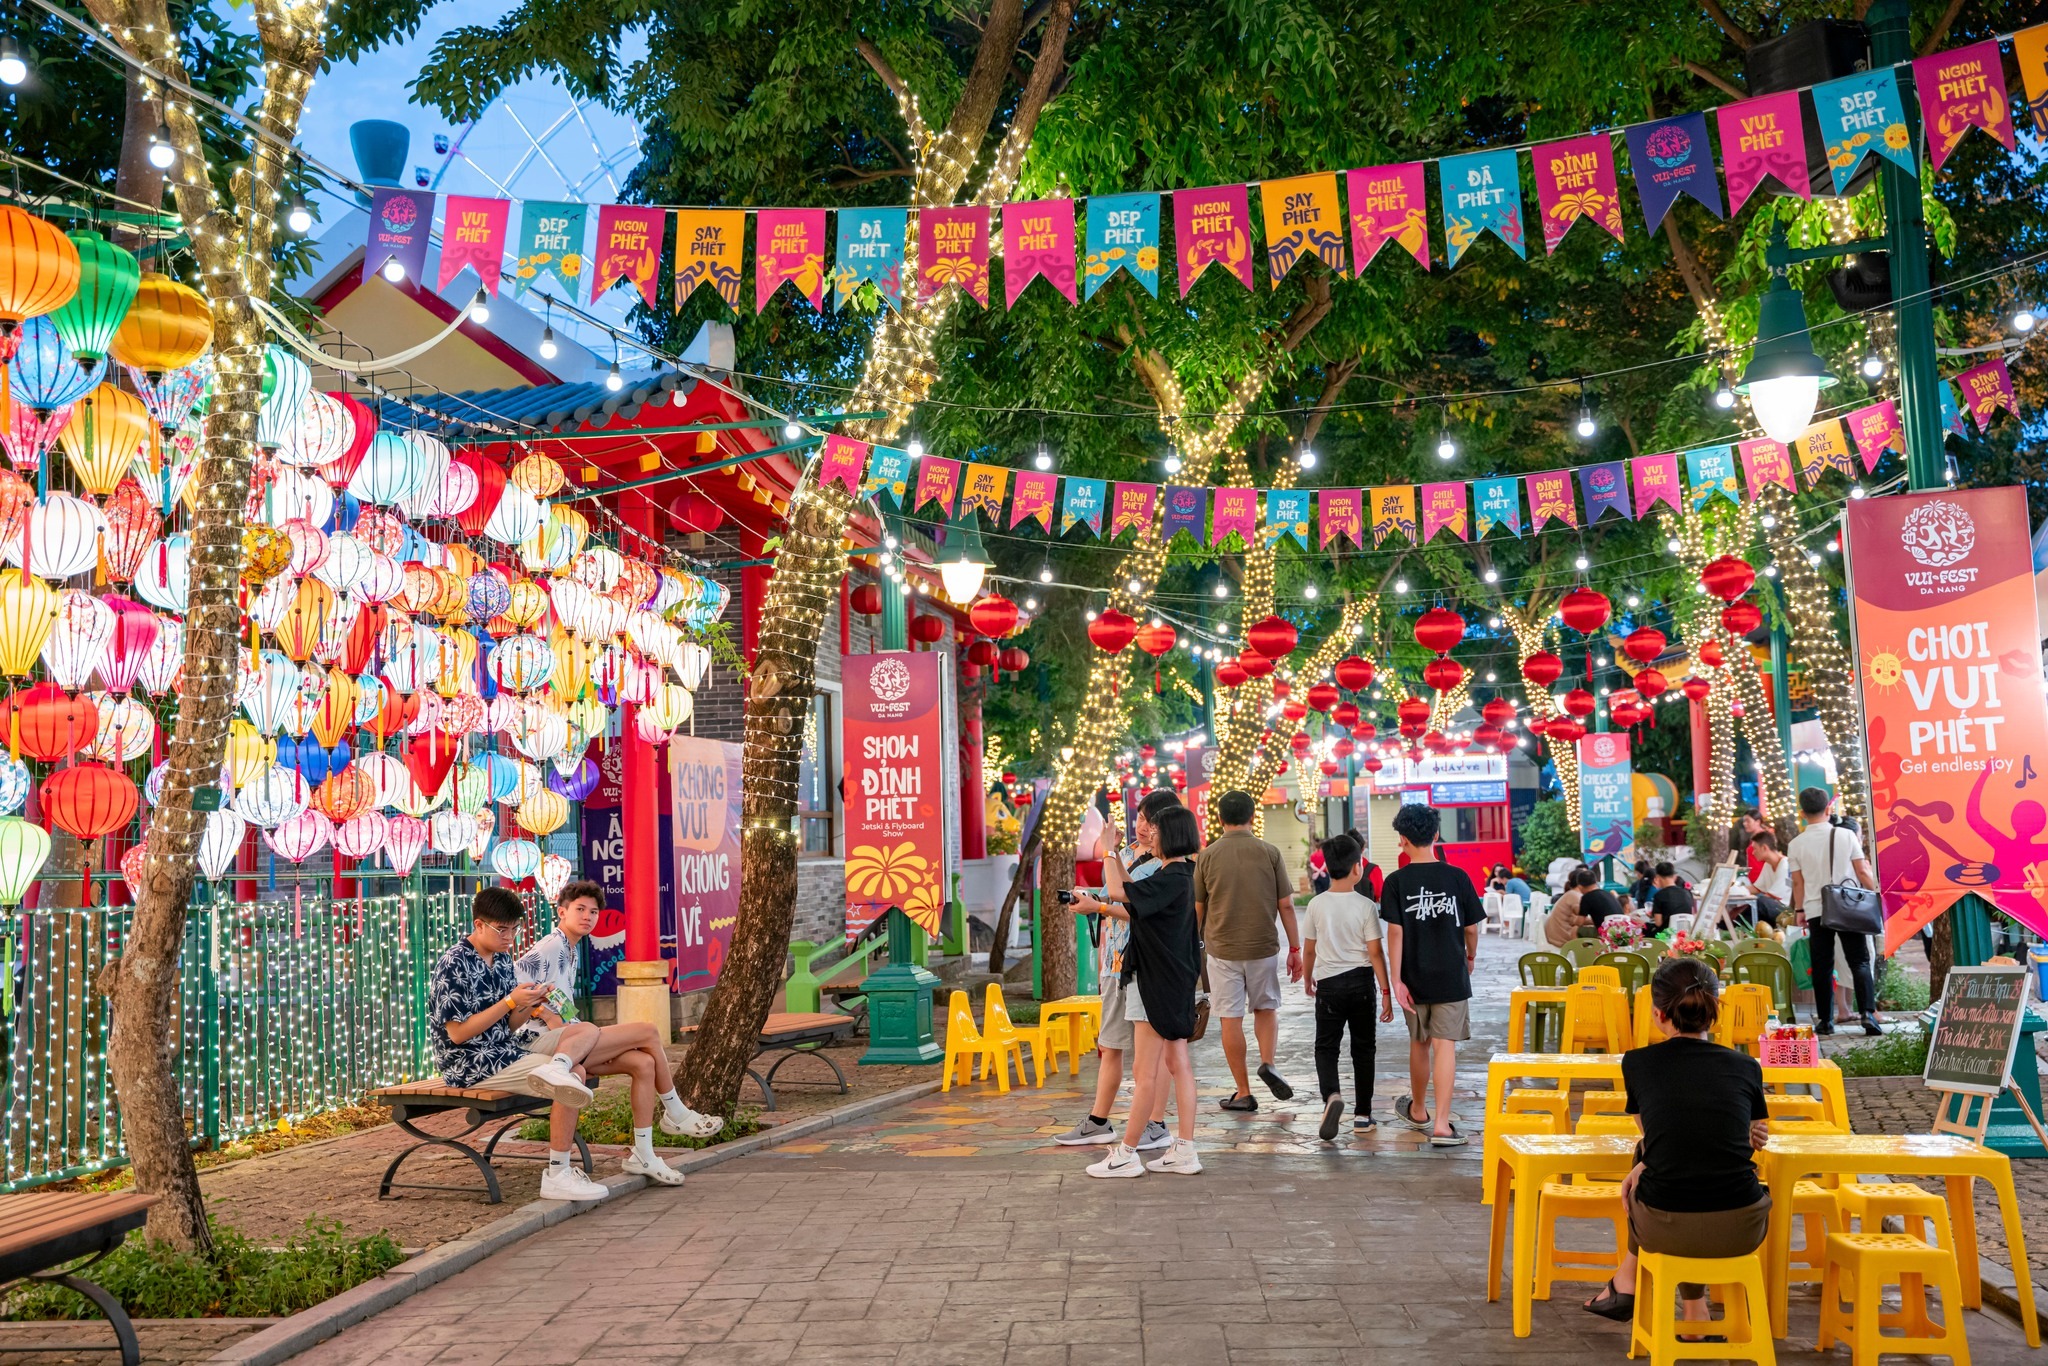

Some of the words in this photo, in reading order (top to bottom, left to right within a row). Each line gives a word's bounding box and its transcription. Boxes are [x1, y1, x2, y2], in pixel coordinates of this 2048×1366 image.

[1938, 59, 1982, 81] NGON
[1938, 74, 1988, 103] PHẾT
[1840, 90, 1877, 115] ĐẸP
[1739, 113, 1776, 135] VUI
[1840, 108, 1886, 132] PHẾT
[1739, 131, 1784, 153] PHẾT
[1551, 151, 1599, 176] ĐỈNH
[1367, 176, 1405, 195] CHILL
[1284, 192, 1313, 211] SAY
[1365, 193, 1408, 213] PHẾT
[1457, 187, 1505, 209] PHẾT
[1193, 201, 1230, 216] NGON
[1282, 208, 1321, 226] PHẾT
[461, 212, 488, 227] VUI
[538, 218, 568, 233] ĐẸP
[614, 220, 647, 233] NGON
[1021, 217, 1052, 235] VUI
[1108, 211, 1141, 229] ĐẸP
[1191, 215, 1234, 235] PHẾT
[456, 227, 491, 243] PHẾT
[695, 226, 722, 241] SAY
[774, 221, 806, 237] CHILL
[933, 218, 976, 240] ĐỈNH
[1104, 227, 1145, 245] PHẾT
[534, 233, 571, 250] PHẾT
[610, 232, 649, 251] PHẾT
[690, 240, 726, 256] PHẾT
[770, 237, 809, 254] PHẾT
[848, 240, 890, 258] PHẾT
[1019, 233, 1058, 251] PHẾT
[1809, 432, 1826, 445] SAY
[1751, 443, 1776, 455] NGON
[929, 464, 950, 474] NGON
[1643, 465, 1663, 475] VUI
[976, 474, 994, 483] SAY
[1025, 481, 1046, 490] CHILL
[1225, 497, 1243, 507] VUI
[1383, 496, 1400, 506] SAY
[1433, 489, 1455, 499] CHILL
[1905, 567, 1979, 587] VUI-FEST
[1920, 586, 1934, 595] DA
[1937, 584, 1966, 594] NANG
[1907, 621, 1990, 662] CHƠI
[1901, 663, 2001, 711] VUI
[870, 702, 910, 713] VUI-FEST
[1909, 708, 2005, 756] PHẾT
[863, 735, 919, 760] SHOW
[1900, 758, 1928, 775] Get
[1931, 755, 1986, 773] endless
[1990, 756, 2014, 774] joy
[677, 761, 724, 800] KHÔNG
[861, 760, 921, 796] ĐỈNH
[866, 792, 918, 821] PHẾT
[679, 802, 709, 841] VUI
[861, 822, 884, 831] Jetski
[892, 821, 925, 832] Flyboard
[882, 830, 904, 838] Show
[681, 850, 729, 896] KHÔNG
[682, 897, 704, 947] VỀ
